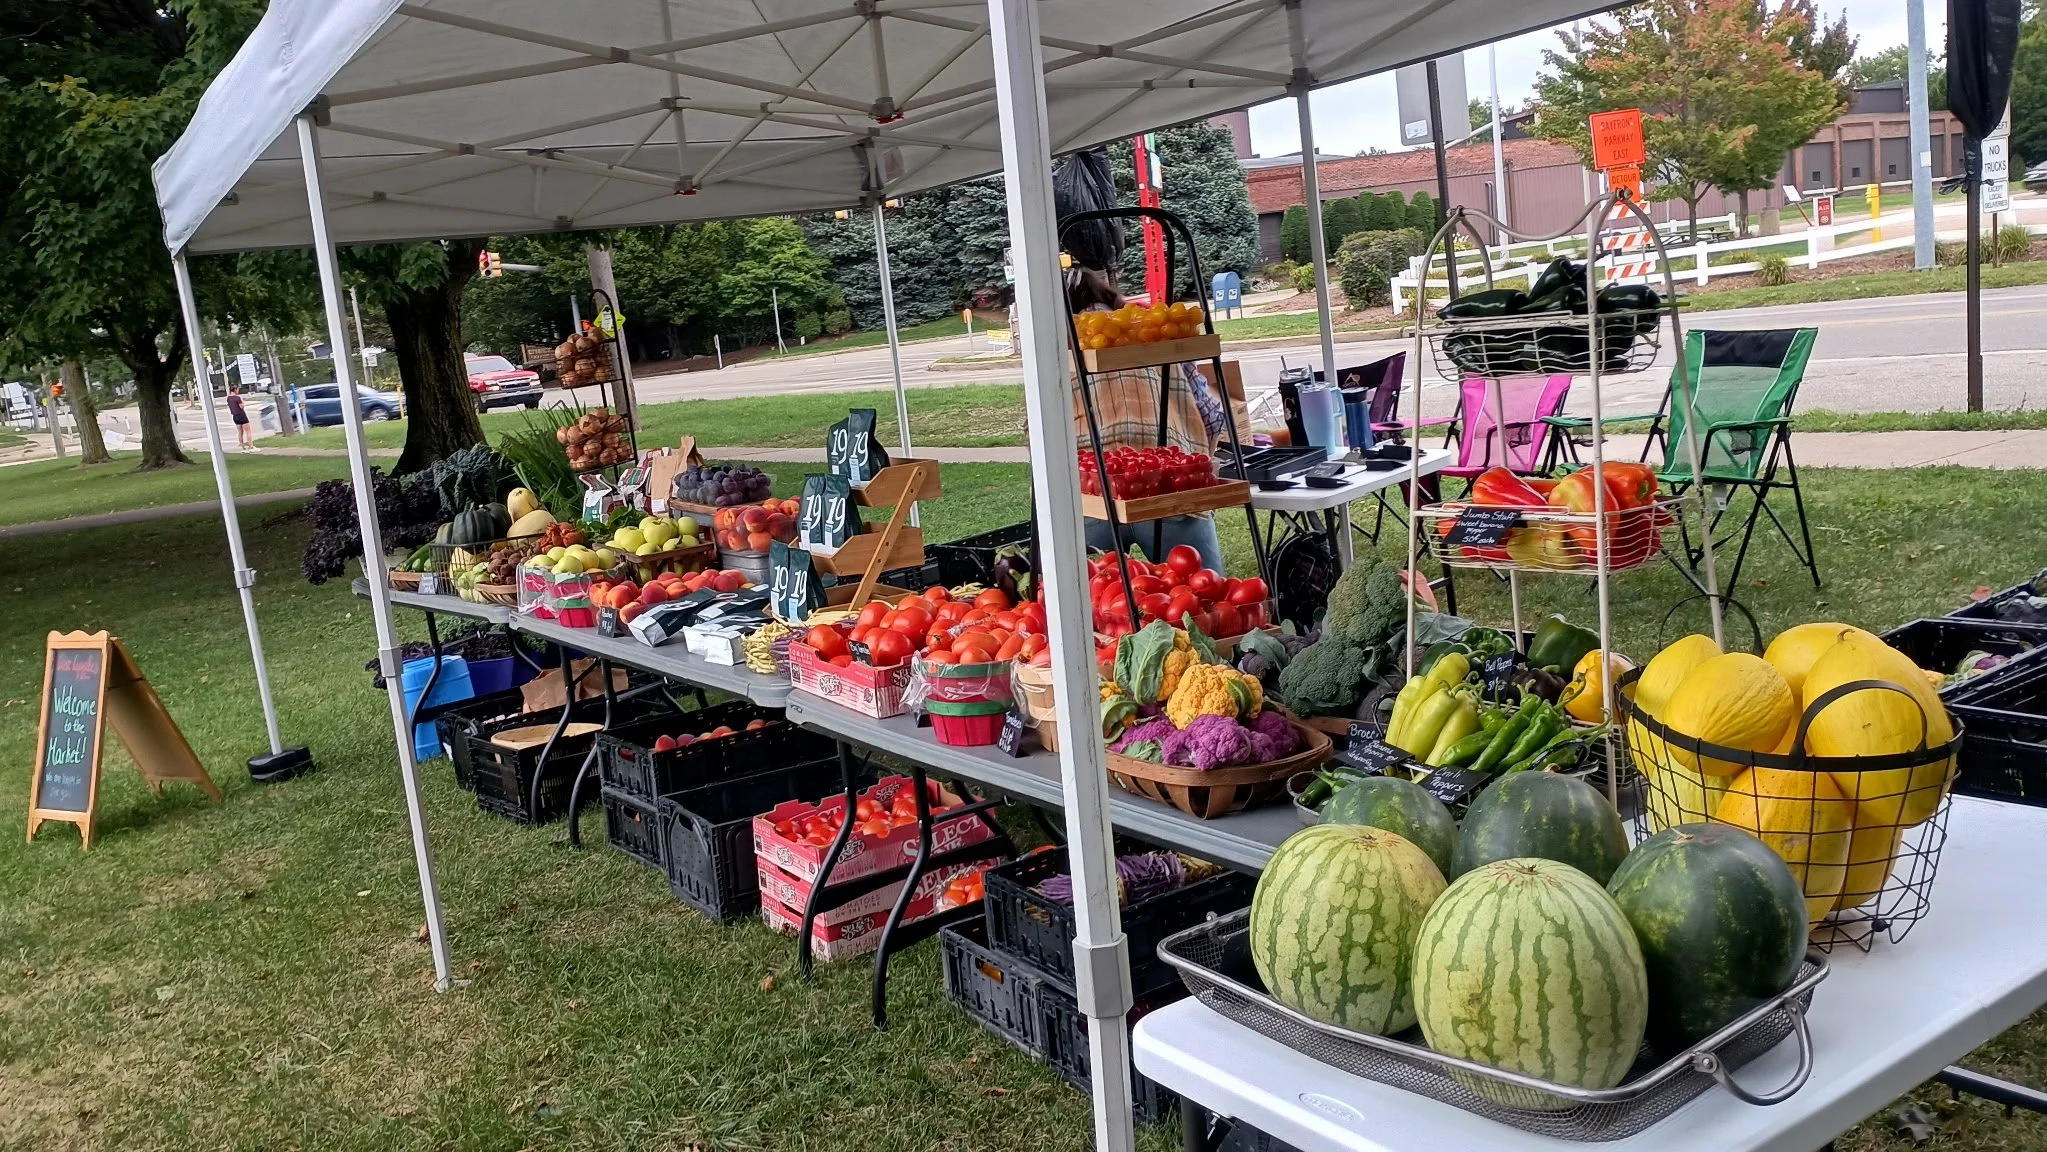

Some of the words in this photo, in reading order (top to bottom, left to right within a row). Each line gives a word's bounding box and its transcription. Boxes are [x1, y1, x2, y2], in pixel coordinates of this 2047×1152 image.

[1604, 133, 1633, 146] PARKWAY
[1613, 149, 1628, 160] EAST
[1989, 145, 2000, 155] NO
[1612, 174, 1637, 184] DETOUR
[1984, 161, 2006, 173] TRUCKS
[831, 428, 848, 465] 19
[850, 431, 869, 467] 19
[803, 494, 822, 529] 19
[825, 497, 846, 533] 19
[1463, 508, 1491, 519] Jumbo
[771, 564, 789, 602] 19
[790, 570, 808, 606] 19
[54, 685, 97, 717] Welcome
[64, 718, 74, 732] to
[73, 718, 85, 735] the
[46, 736, 88, 767] Market!
[903, 815, 981, 859] SLECT
